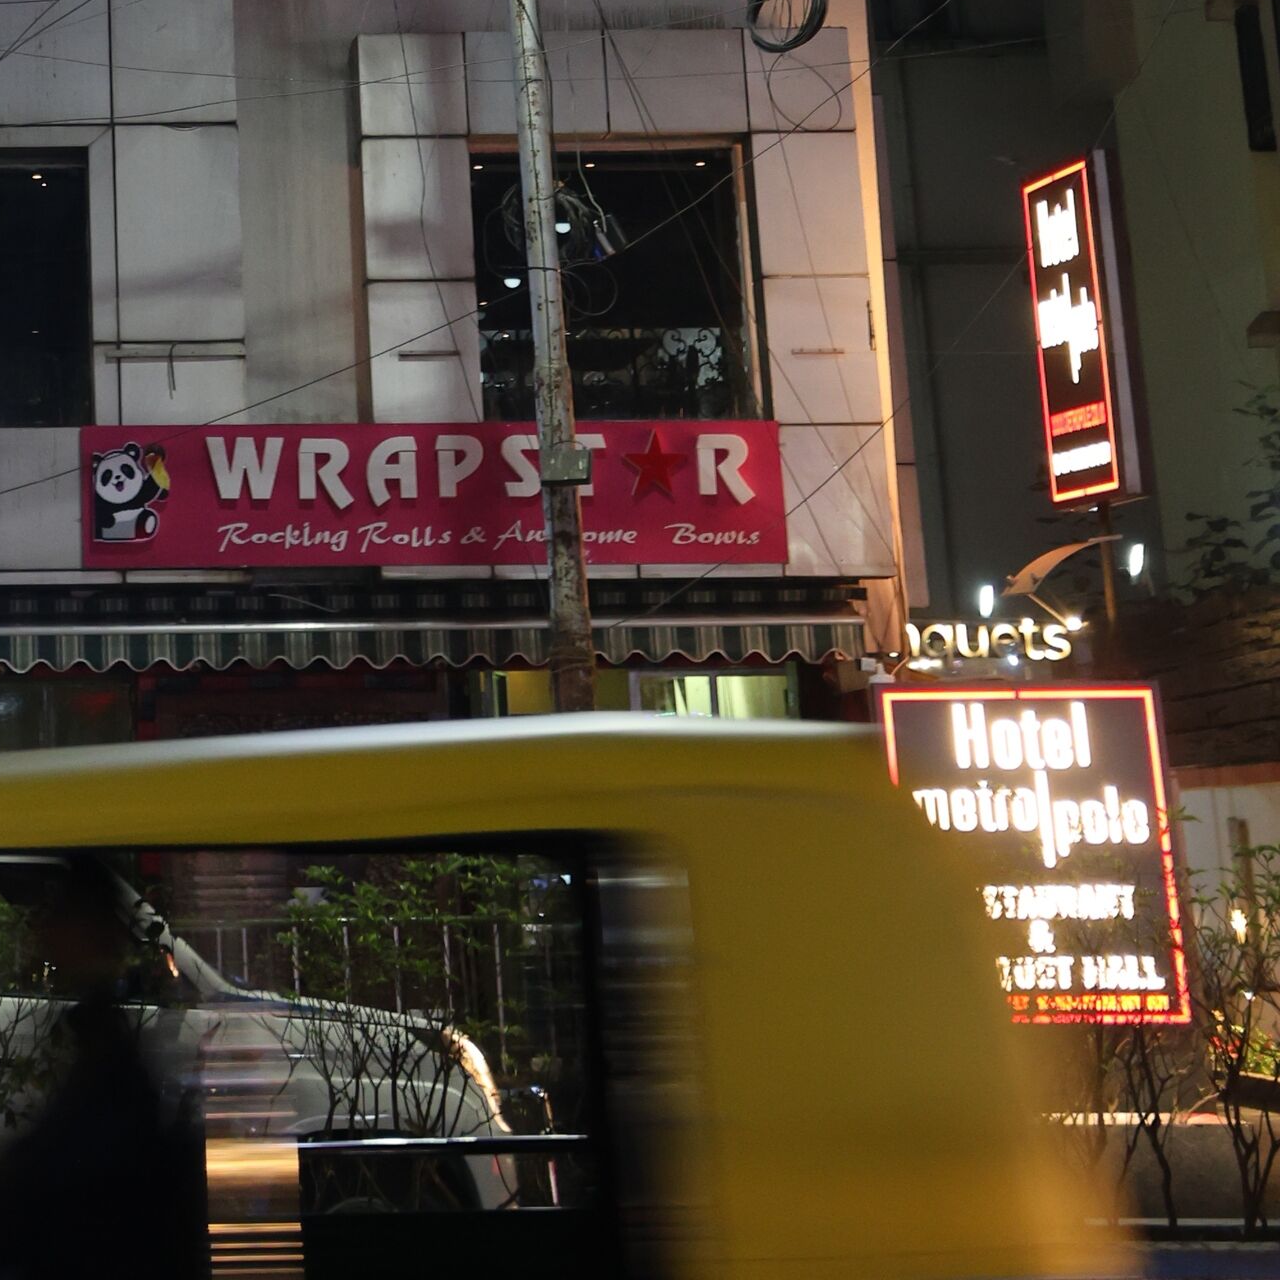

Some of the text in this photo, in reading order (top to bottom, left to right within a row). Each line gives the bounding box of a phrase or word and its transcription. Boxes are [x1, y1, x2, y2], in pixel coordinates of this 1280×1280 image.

[217, 522, 349, 552] Rocking
[357, 522, 452, 552] Rolls
[460, 526, 487, 544] &
[493, 520, 637, 551] Awome
[951, 701, 1091, 770] Hotel
